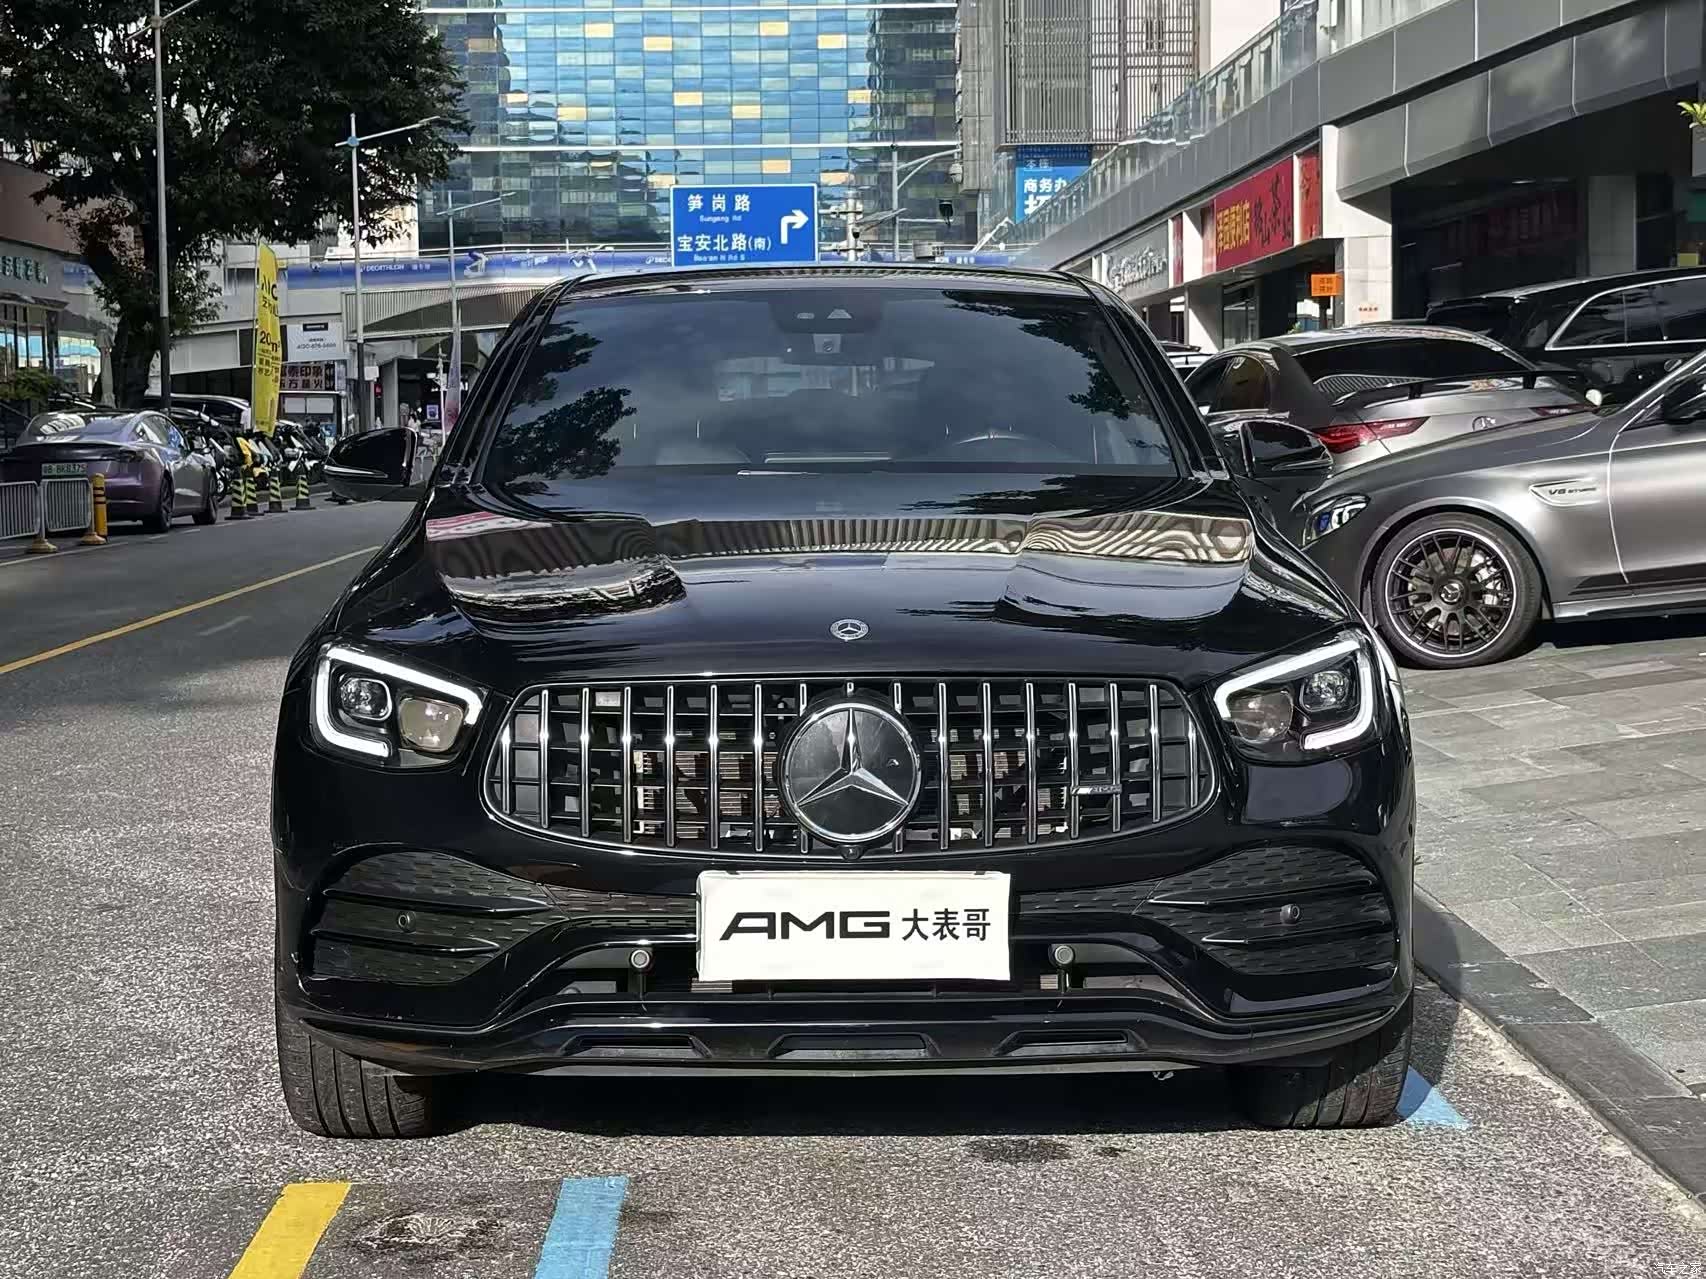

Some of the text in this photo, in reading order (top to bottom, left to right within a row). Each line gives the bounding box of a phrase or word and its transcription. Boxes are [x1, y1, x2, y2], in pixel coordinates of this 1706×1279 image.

[687, 193, 751, 213] 笋岗路
[732, 214, 742, 222] Rd
[719, 908, 991, 941] AMG 大表哥
